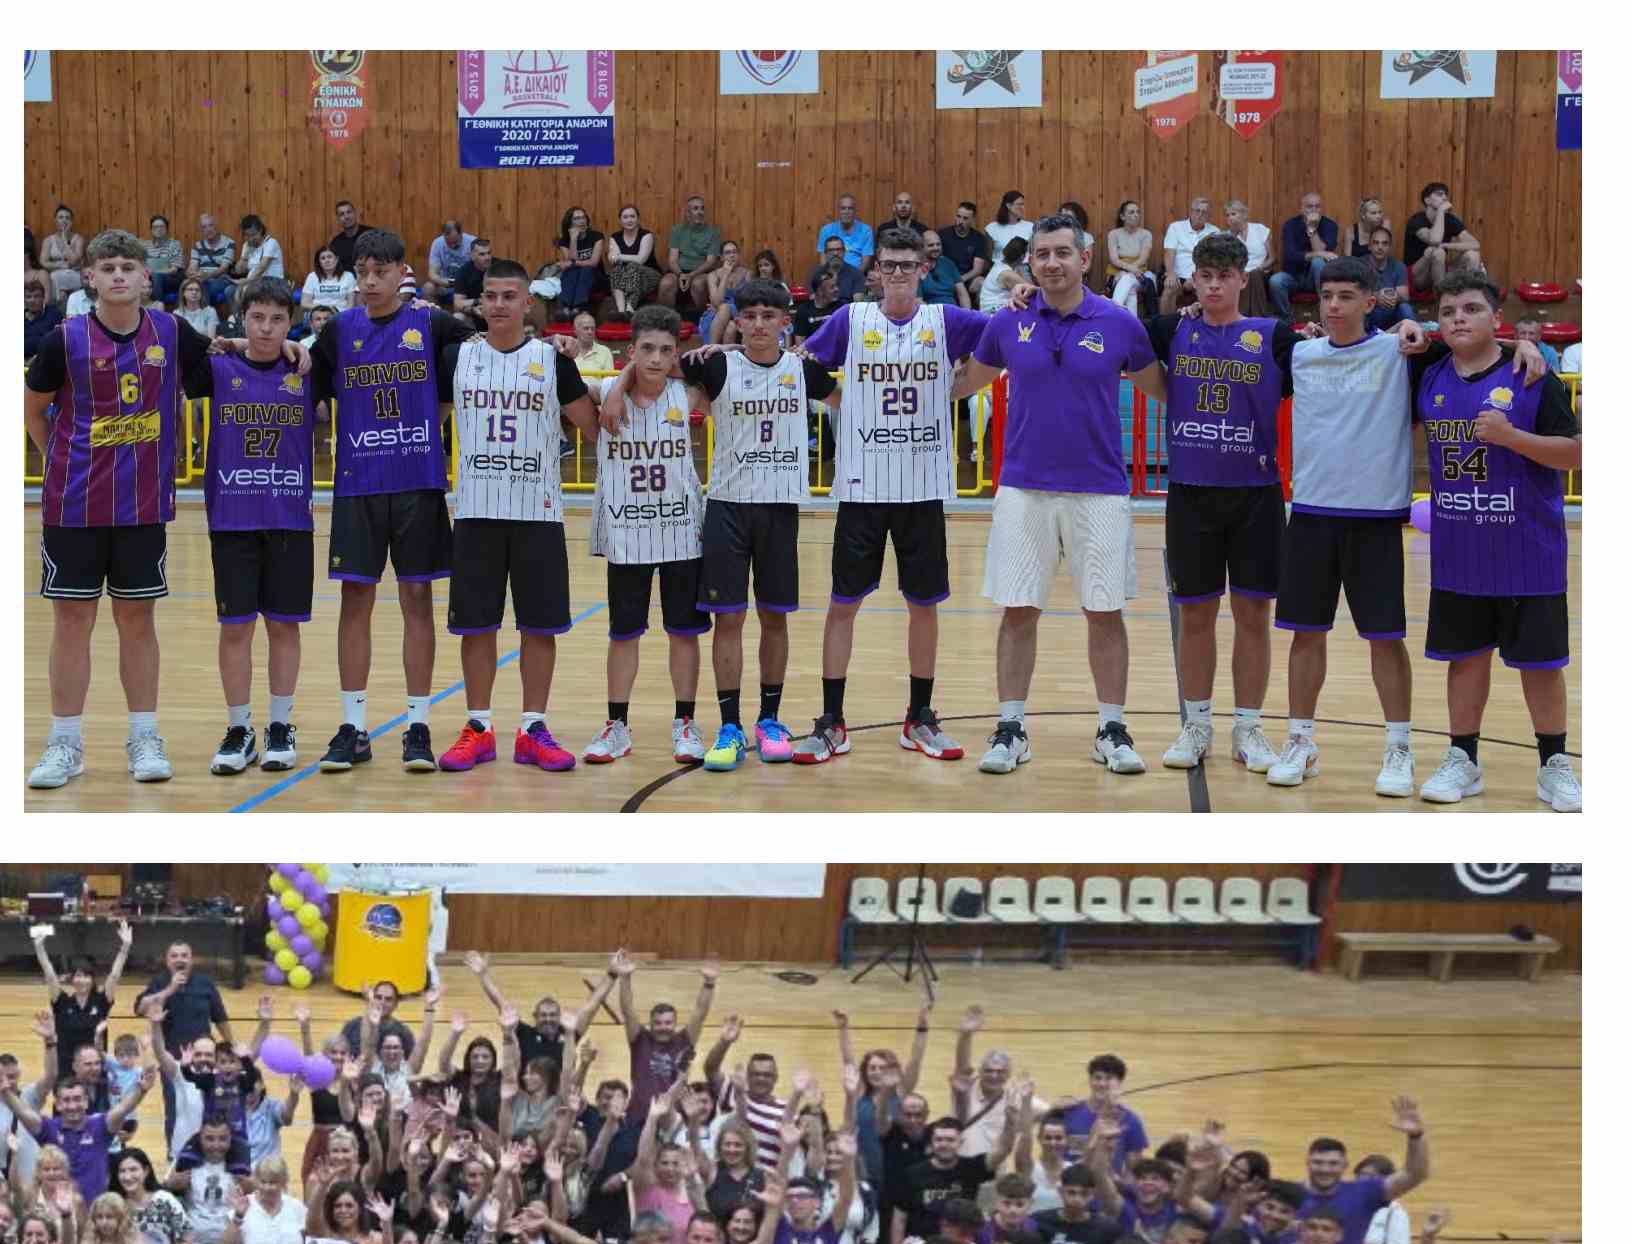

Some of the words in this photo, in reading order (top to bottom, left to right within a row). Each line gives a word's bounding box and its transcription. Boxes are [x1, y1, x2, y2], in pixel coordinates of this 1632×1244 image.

[525, 72, 568, 95] ΔΙΚΑΙΟΥ
[511, 119, 564, 129] ΚΑΤΗΓΟΡΙΑ
[566, 119, 608, 128] ΑΝΔΡΩΝ
[1233, 112, 1261, 124] 1978
[502, 130, 532, 141] 2020
[542, 130, 571, 141] 2021
[498, 155, 530, 165] 2021
[538, 155, 576, 165] 2022
[344, 362, 428, 388] FOIVOS
[858, 362, 938, 382] FOIVOS
[1174, 355, 1261, 383] FOIVOS
[120, 373, 139, 405] 6
[1196, 384, 1230, 414] 13
[374, 387, 400, 419] 11
[462, 390, 545, 411] FOIVOS
[733, 399, 799, 415] FOIVOS
[882, 387, 918, 416] 29
[220, 403, 304, 425] FOIVOS
[349, 420, 429, 448] vestal
[486, 415, 518, 443] 15
[760, 420, 773, 443] 8
[858, 419, 940, 444] vestal
[1172, 419, 1254, 443] vestal
[1425, 420, 1488, 442] FOIV
[244, 428, 281, 458] 27
[401, 445, 431, 456] group
[607, 439, 686, 460] FOIVOS
[912, 445, 942, 455] group
[1220, 444, 1255, 454] group
[466, 450, 541, 472] vestal
[735, 447, 799, 464] vestal
[1442, 446, 1488, 481] 54
[219, 463, 303, 486] vestal
[510, 474, 542, 484] group
[630, 464, 666, 493] 28
[272, 488, 304, 497] group
[1435, 486, 1515, 512] vestal
[609, 495, 689, 519] vestal
[660, 518, 691, 528] group
[1475, 514, 1516, 525] group
